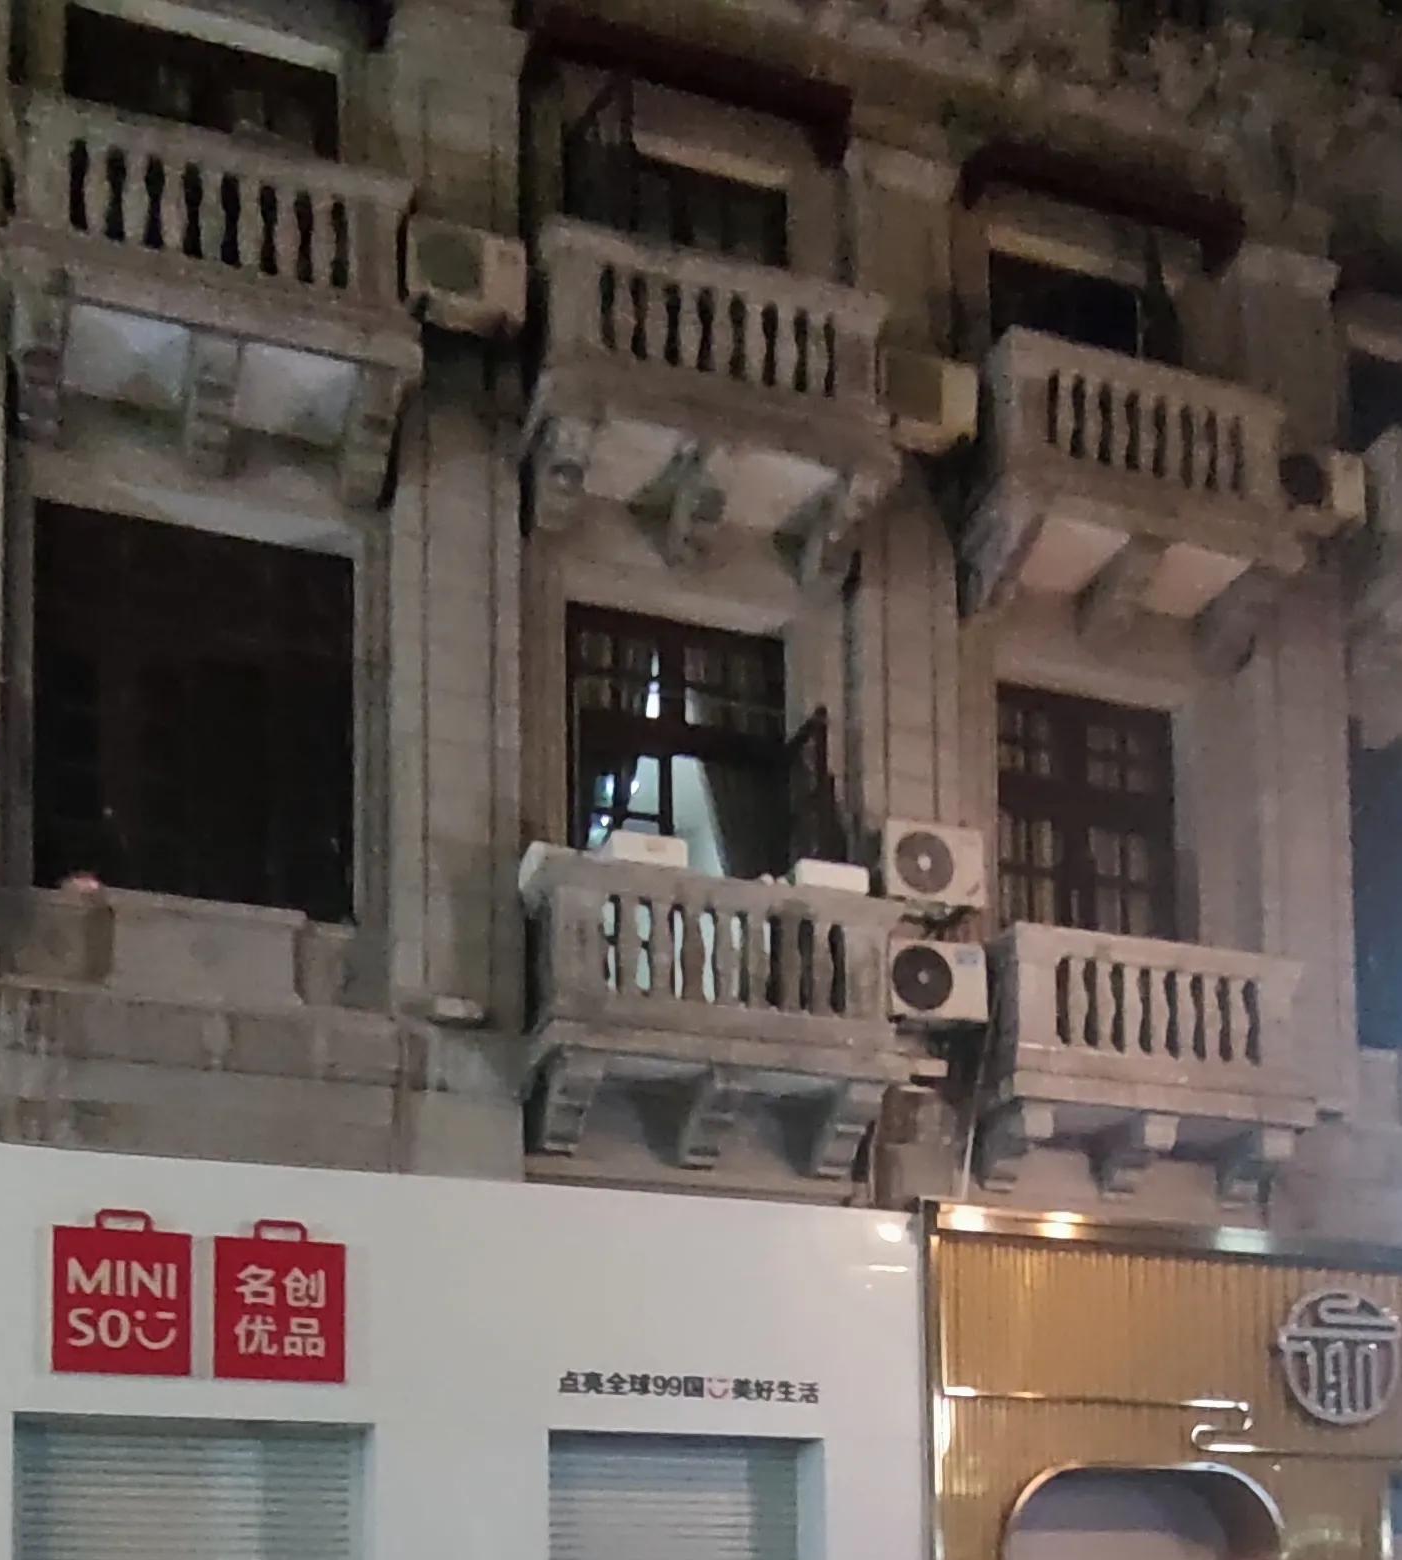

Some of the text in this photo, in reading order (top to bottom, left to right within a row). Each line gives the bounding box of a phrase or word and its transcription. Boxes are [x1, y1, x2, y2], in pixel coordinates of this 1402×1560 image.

[67, 1257, 178, 1300] MINI
[235, 1264, 327, 1309] 名创
[233, 1313, 326, 1359] 优品
